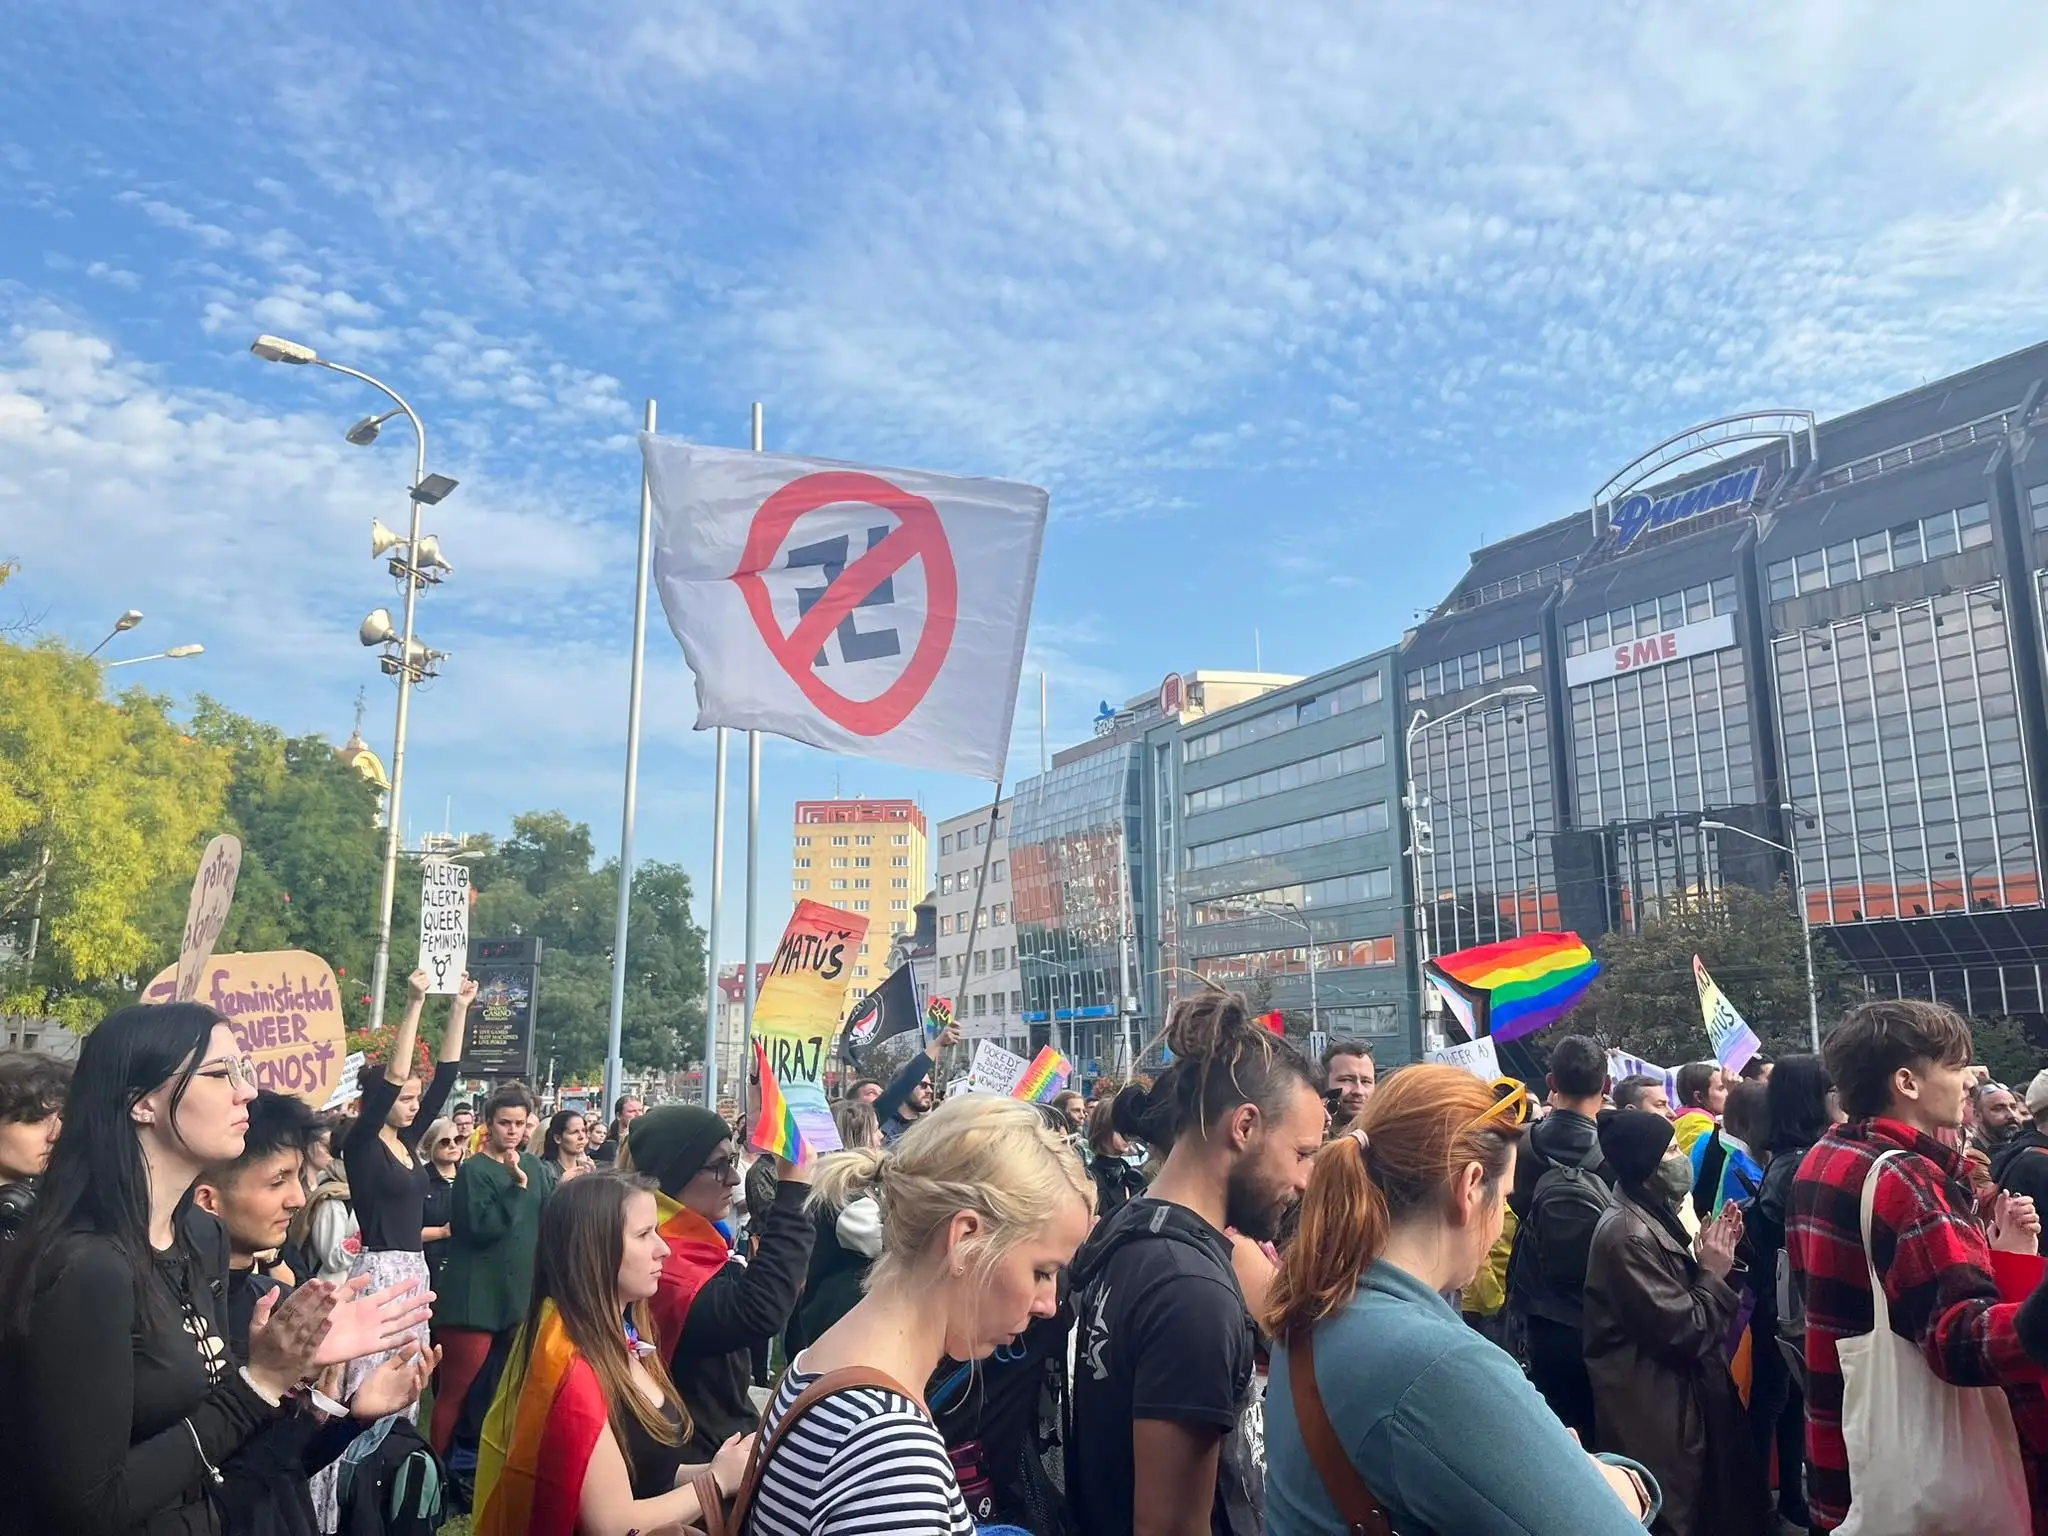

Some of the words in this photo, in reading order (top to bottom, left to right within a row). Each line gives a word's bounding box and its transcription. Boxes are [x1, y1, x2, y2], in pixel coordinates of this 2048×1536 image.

[1608, 466, 1763, 552] Dunaj
[1615, 633, 1677, 671] SME
[423, 890, 465, 907] ALERTA
[423, 909, 463, 931] QUEER
[422, 932, 466, 952] FEMINISTA
[770, 931, 851, 980] MATÚŠ
[210, 969, 334, 1016] feministickú
[229, 1012, 312, 1053] QUEER
[983, 1045, 1022, 1068] DOKEDY
[984, 1058, 1017, 1077] BUDEME
